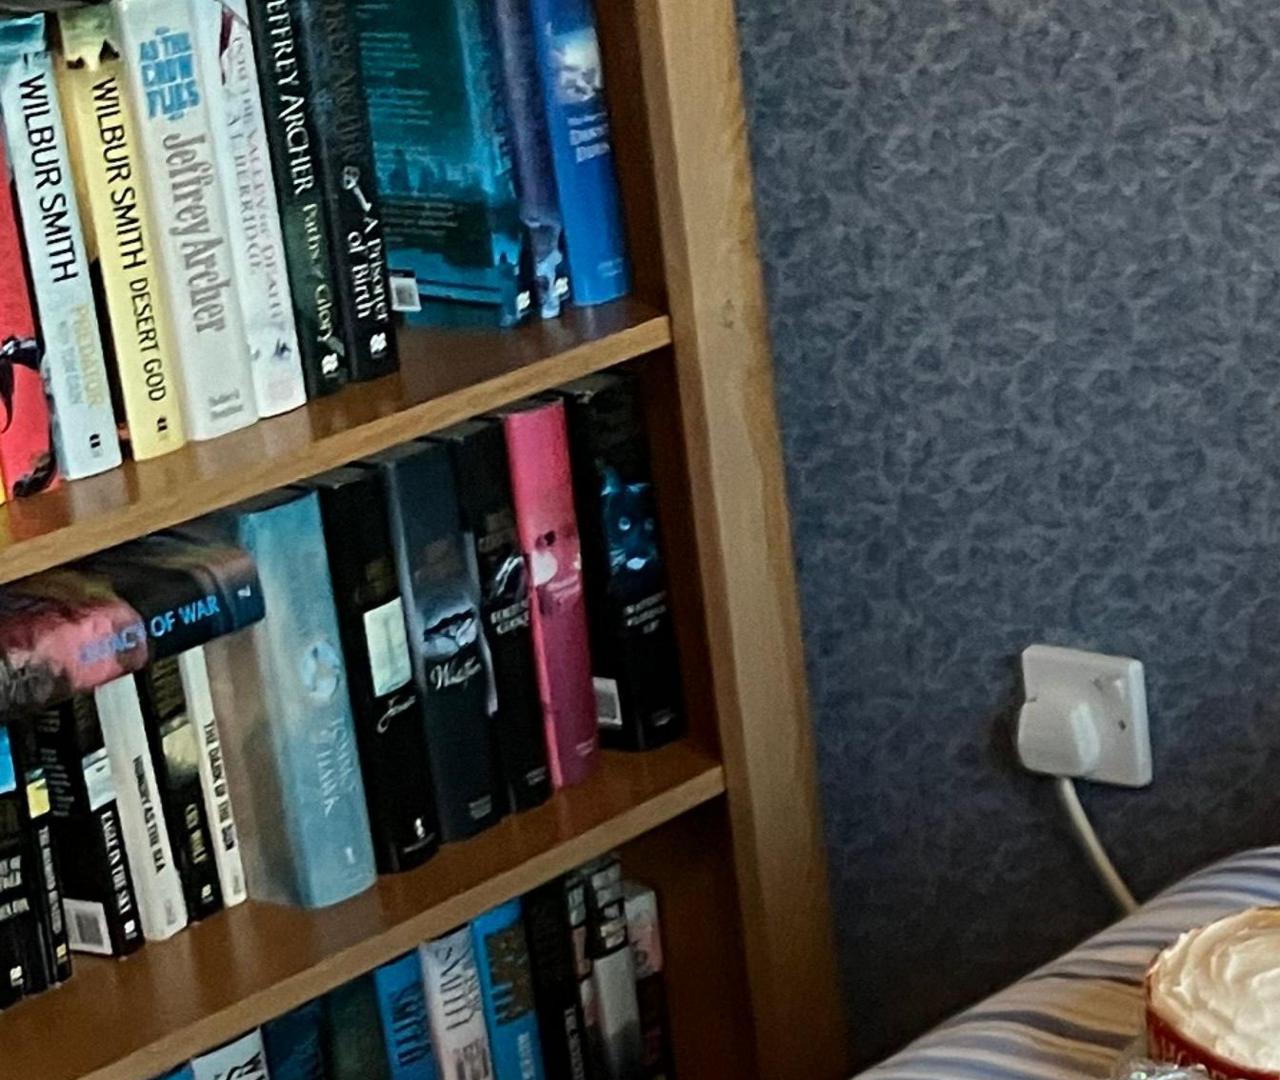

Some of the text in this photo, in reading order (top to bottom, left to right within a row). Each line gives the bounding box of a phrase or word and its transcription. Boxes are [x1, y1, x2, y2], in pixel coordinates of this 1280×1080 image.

[266, 0, 316, 196] EFFREY ARCHER
[19, 72, 79, 283] WILBUR SMITH
[92, 77, 167, 402] WILBUR SMITH DESERT GOD
[162, 133, 232, 334] Jeffrey Archer
[347, 230, 375, 319] of Birth
[362, 216, 390, 323] A Prisoner
[314, 283, 334, 342] Glory
[150, 610, 176, 638] OF
[178, 594, 221, 625] WAR
[100, 810, 118, 849] EAGLE
[112, 865, 126, 890] THE
[117, 891, 132, 915] SKY
